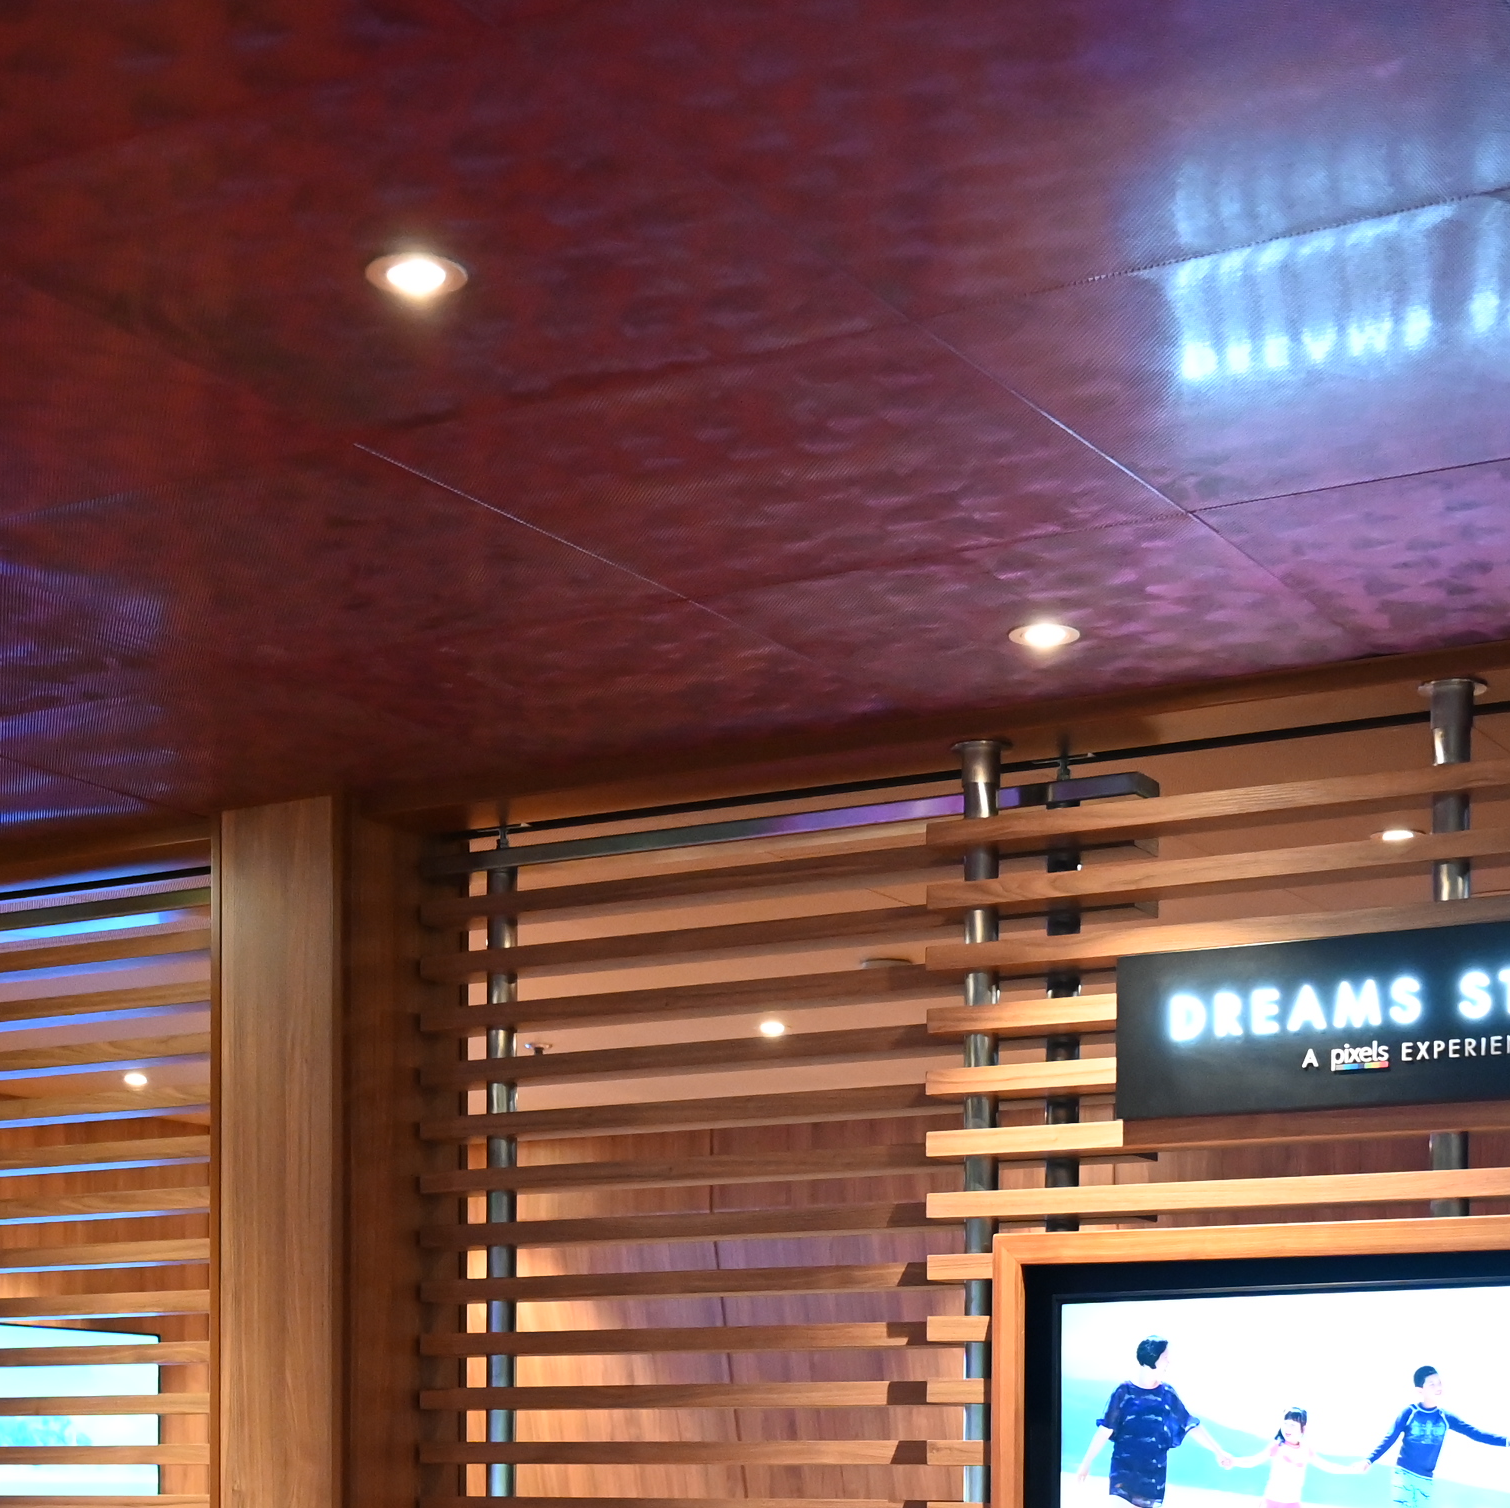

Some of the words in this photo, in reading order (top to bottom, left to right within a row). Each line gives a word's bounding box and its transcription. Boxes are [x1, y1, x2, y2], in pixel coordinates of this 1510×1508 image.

[1168, 975, 1422, 1042] DREAMS
[1301, 1048, 1320, 1069] A
[1330, 1040, 1389, 1071] pixels
